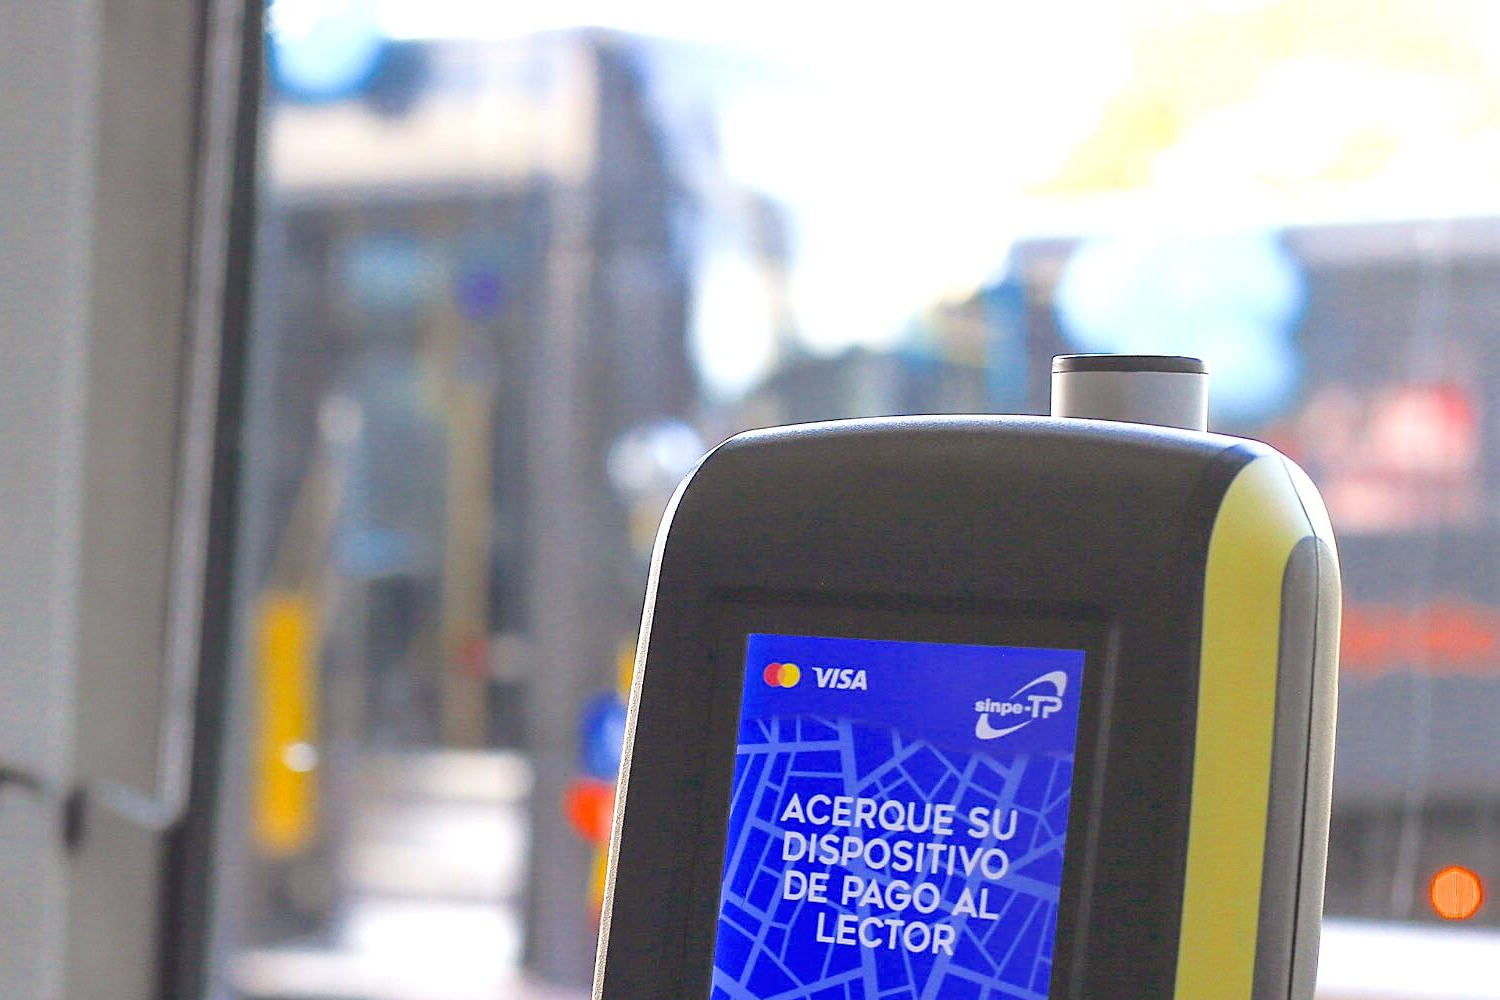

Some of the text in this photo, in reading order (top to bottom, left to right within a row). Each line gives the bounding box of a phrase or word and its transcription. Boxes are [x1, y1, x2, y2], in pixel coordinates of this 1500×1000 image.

[812, 667, 867, 690] VISA
[780, 793, 1017, 840] ACERQUE SU
[782, 831, 1009, 880] DISPOSITIVO
[783, 870, 999, 920] DE PAGO AL
[816, 912, 955, 956] LECTOR
